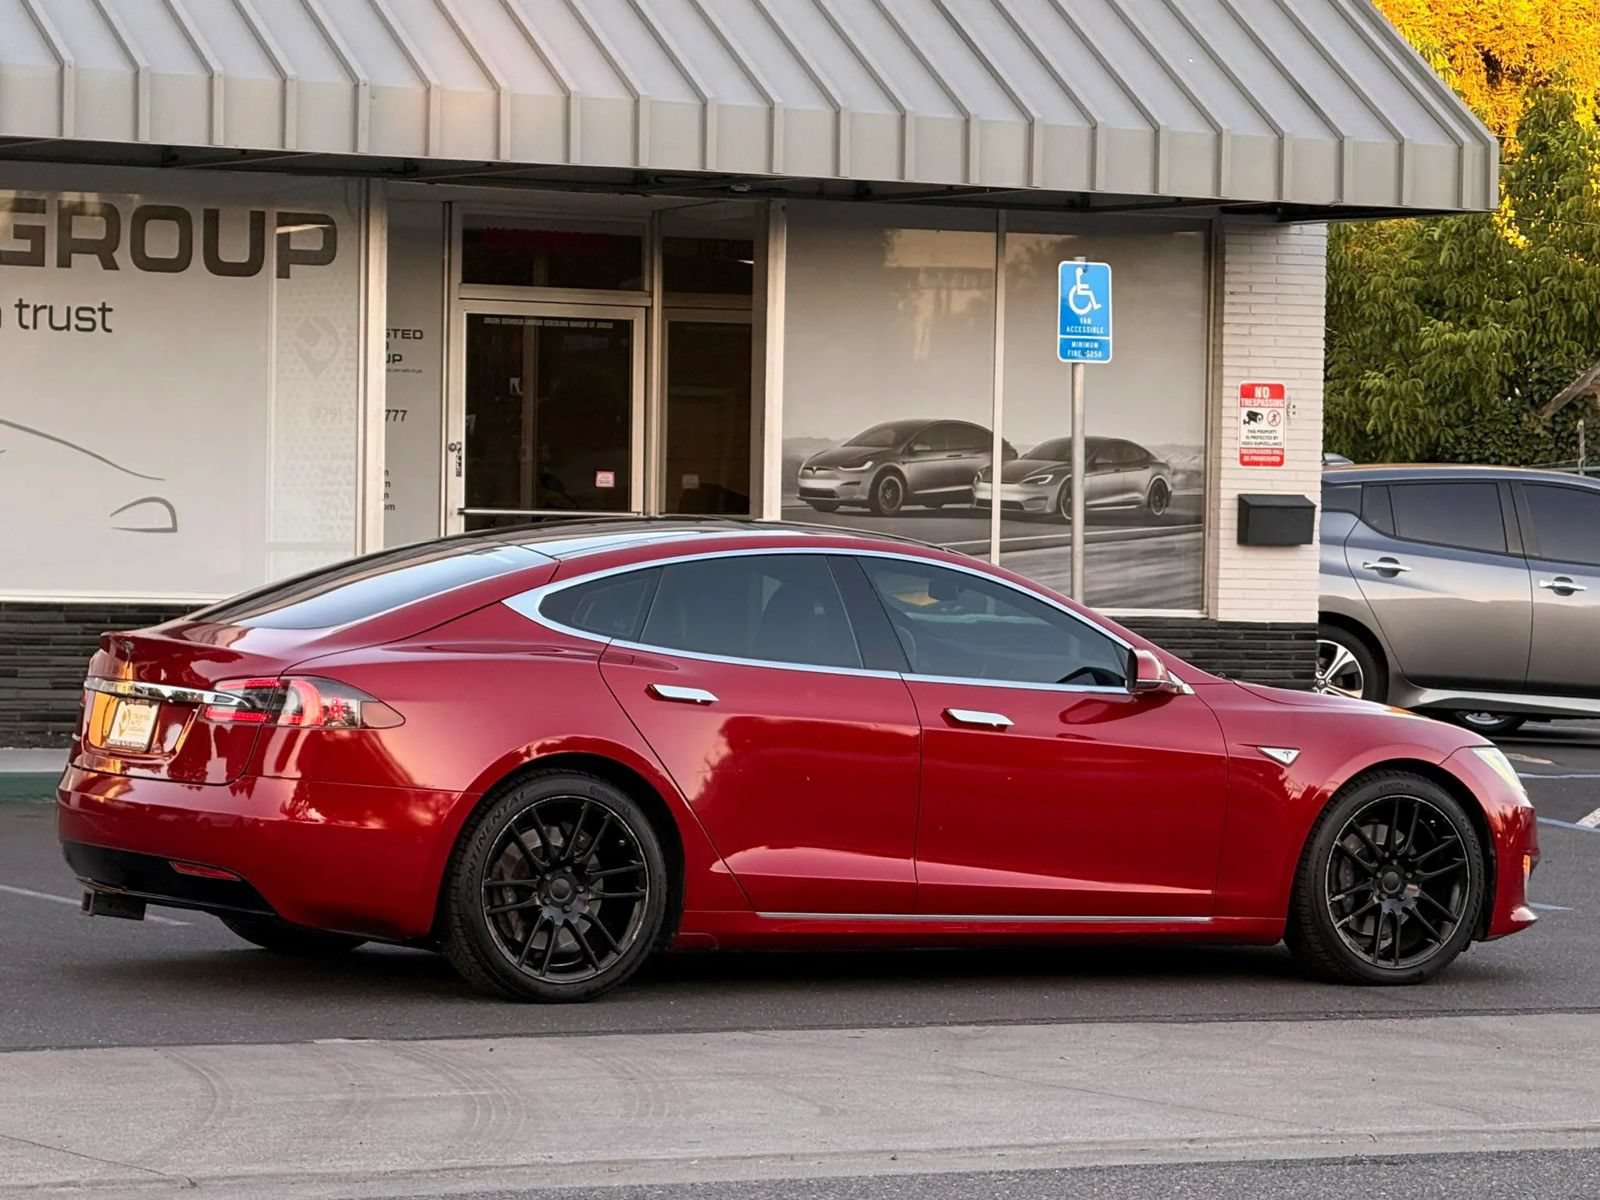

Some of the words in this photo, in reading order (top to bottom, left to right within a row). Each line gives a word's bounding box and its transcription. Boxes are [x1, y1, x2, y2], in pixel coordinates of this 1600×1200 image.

[0, 197, 338, 279] GROUP
[14, 297, 114, 334] trust
[1079, 317, 1092, 325] VAN
[1066, 325, 1105, 334] ACCESSIBLE
[1067, 349, 1082, 357] FINE
[1254, 386, 1270, 398] NO
[1240, 398, 1284, 407] TRESPASSING
